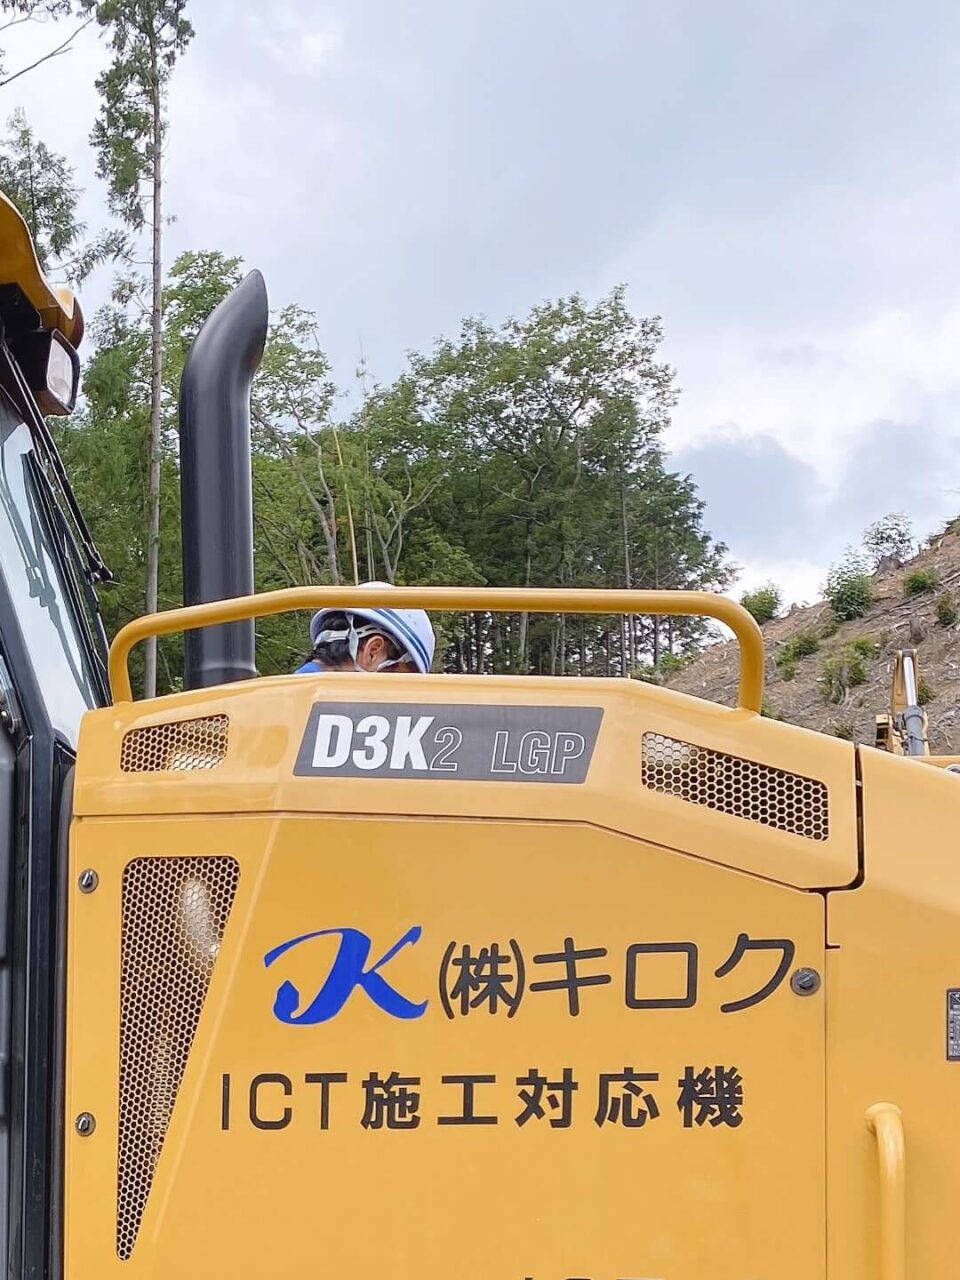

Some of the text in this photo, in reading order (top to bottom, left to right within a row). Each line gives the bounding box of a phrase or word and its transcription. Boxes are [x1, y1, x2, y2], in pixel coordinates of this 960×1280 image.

[311, 713, 585, 775] D3K2 LGP
[220, 1065, 744, 1131] ICT施工対応機
